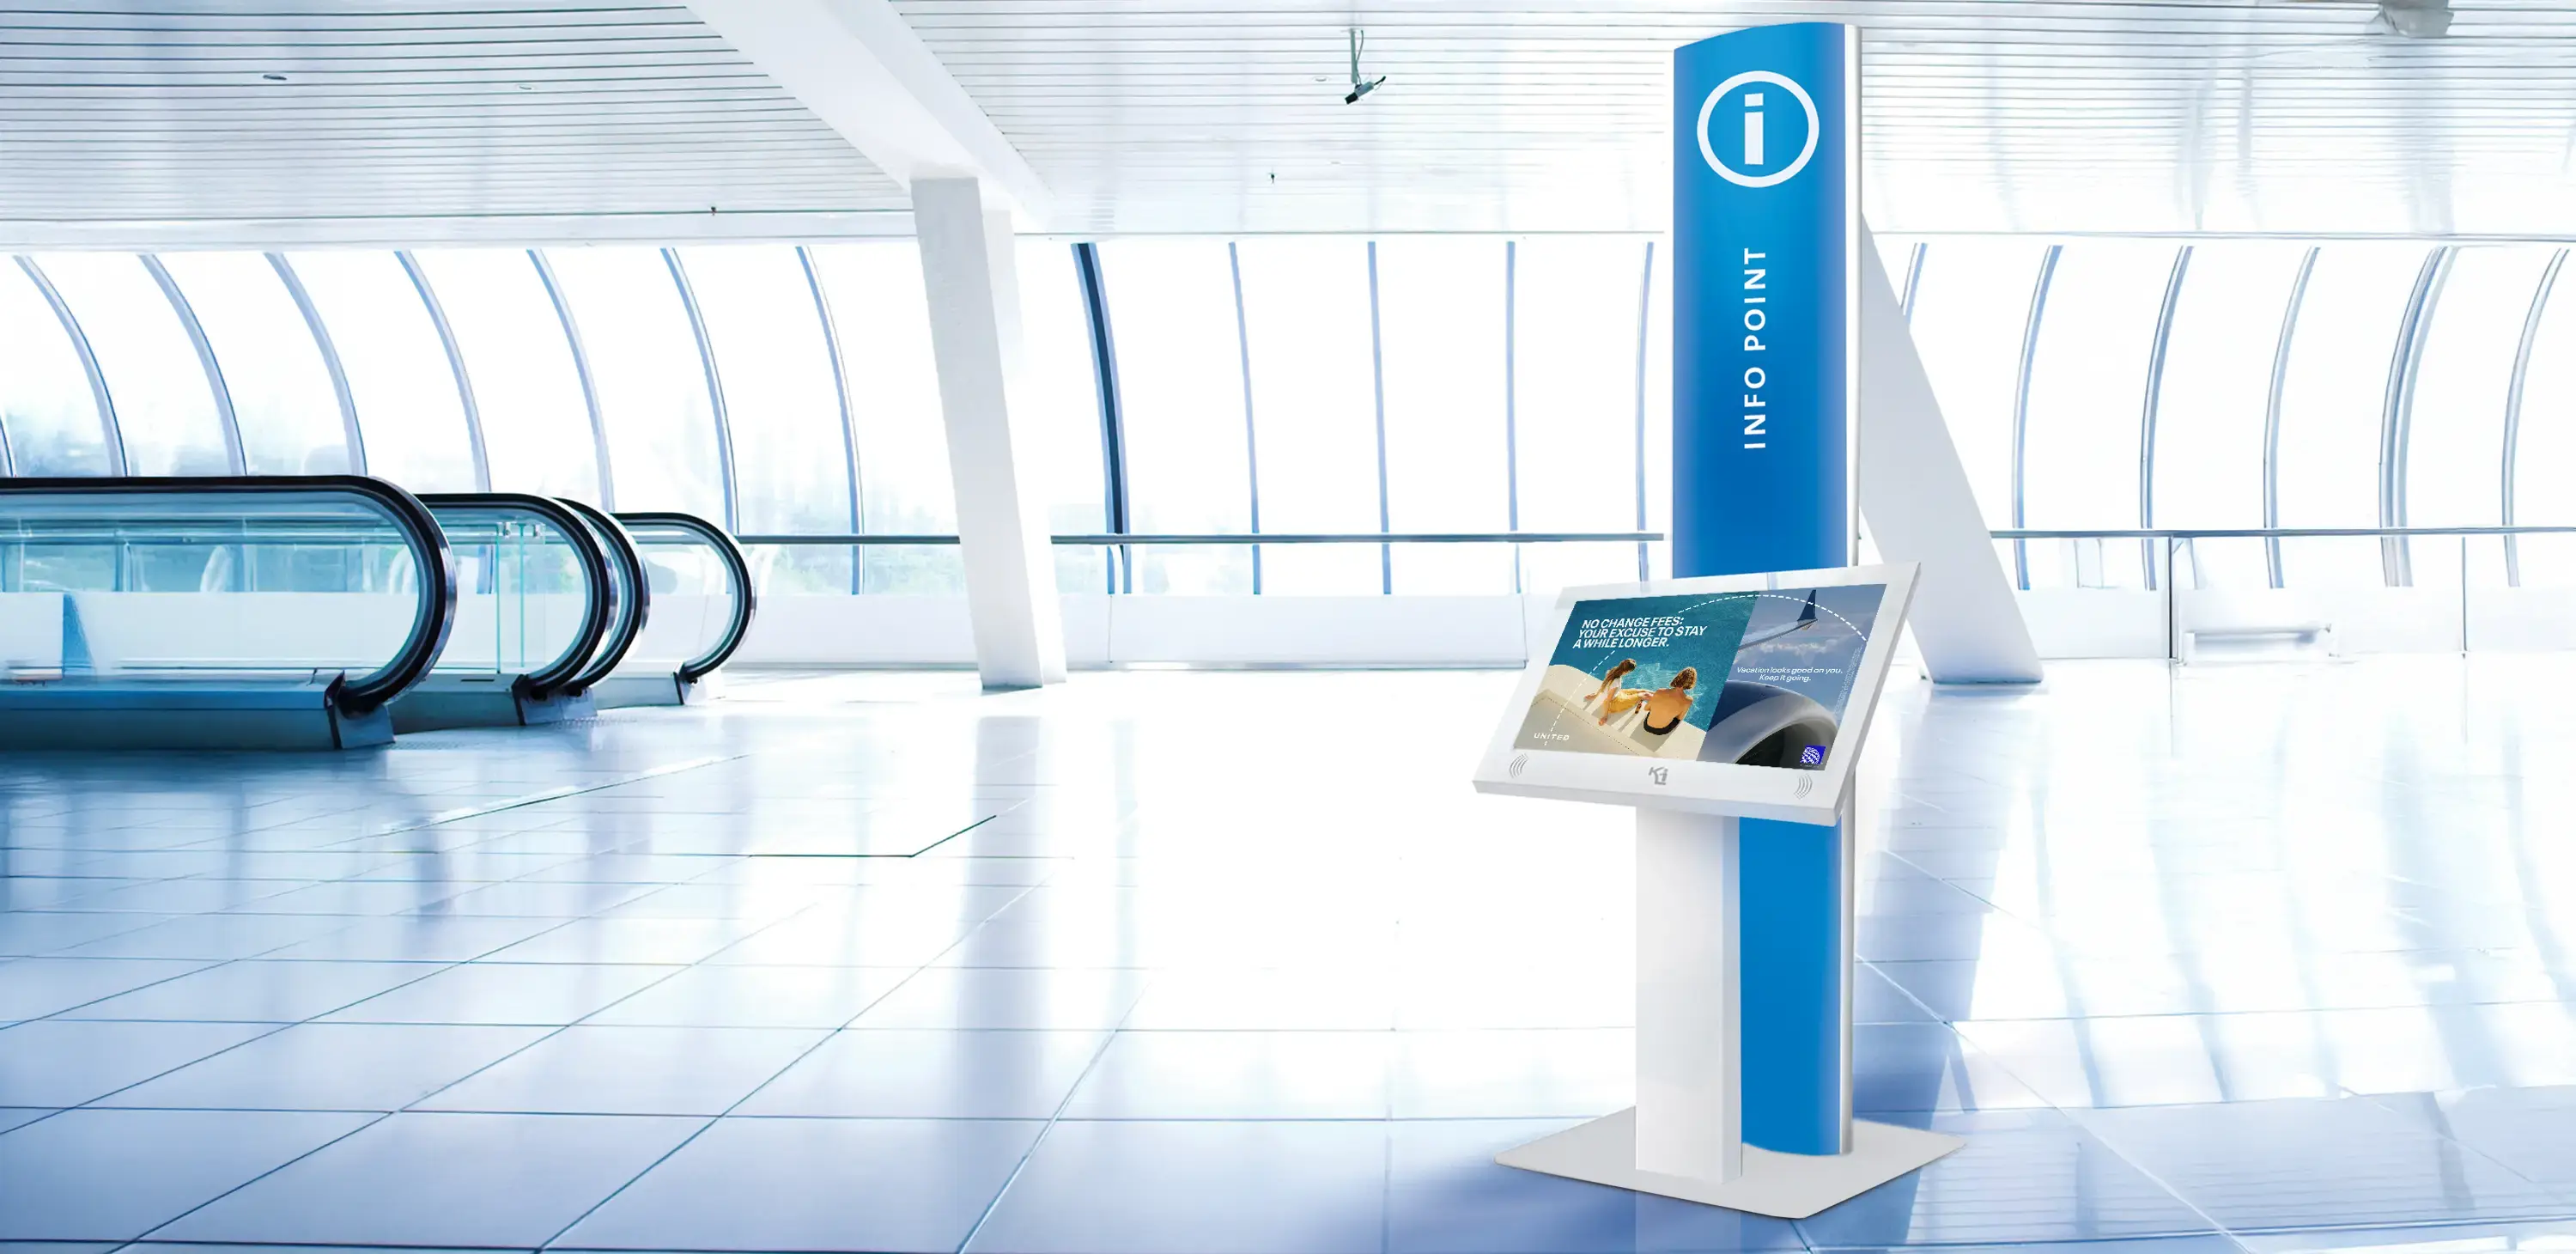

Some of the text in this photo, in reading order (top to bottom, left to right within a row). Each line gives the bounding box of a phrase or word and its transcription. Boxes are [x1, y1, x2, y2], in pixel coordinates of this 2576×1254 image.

[1744, 247, 1766, 449] INFO POINT
[1582, 616, 1685, 629] NO CHANGE FEES:
[1578, 625, 1708, 639] YOUR EXCUSE TO STAY
[1572, 636, 1669, 649] A WHILE LONGER.
[1786, 674, 1812, 683] going.
